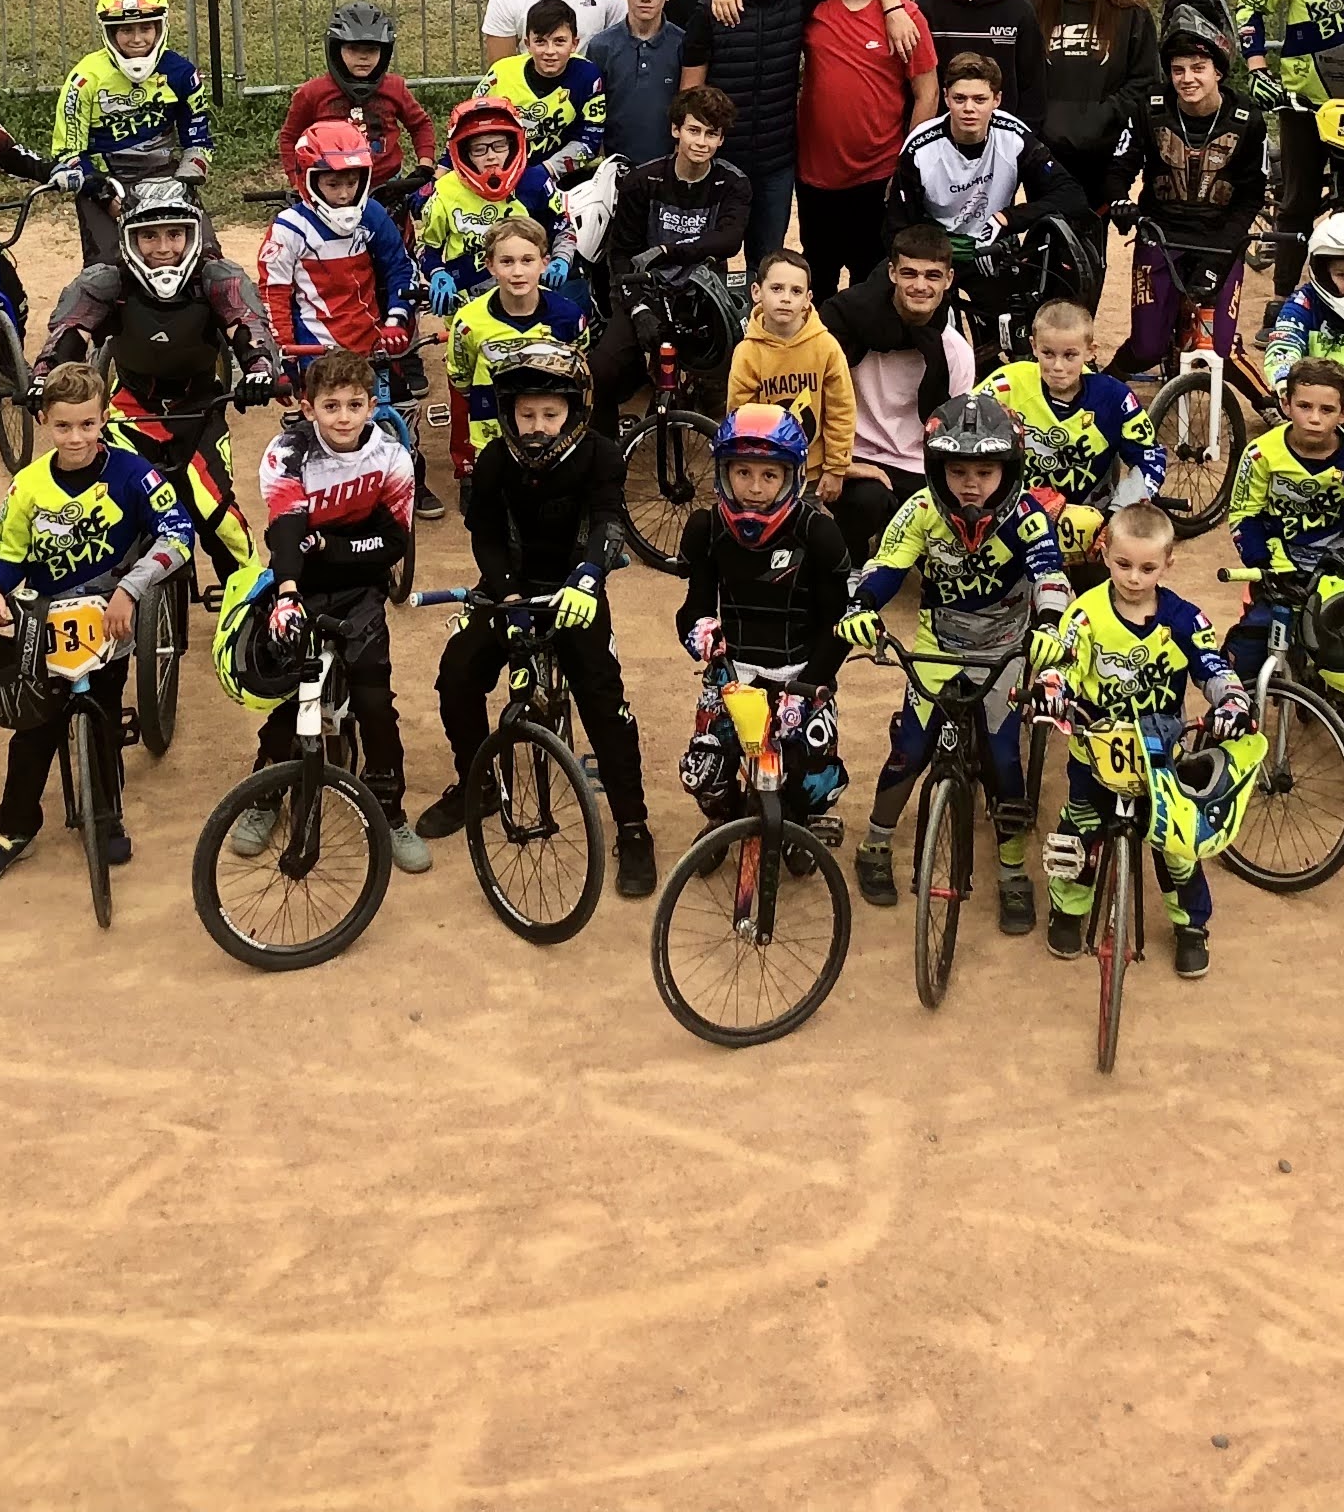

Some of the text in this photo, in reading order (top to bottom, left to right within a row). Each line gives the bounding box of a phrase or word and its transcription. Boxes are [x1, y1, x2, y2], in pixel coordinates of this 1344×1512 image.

[989, 25, 1018, 37] NASA
[587, 101, 607, 118] 65
[658, 207, 708, 228] Les Gets
[245, 371, 273, 385] FOX
[755, 372, 818, 404] PIKACHU
[1131, 418, 1154, 442] 39
[156, 489, 175, 507] 03
[305, 469, 385, 514] THOR
[32, 505, 111, 562] ISSOIRE
[1024, 519, 1041, 536] 11
[1282, 505, 1341, 539] BMX
[46, 530, 115, 581] BMX
[349, 535, 385, 553] THOR
[929, 544, 1001, 582] ISSOIRE
[936, 572, 1003, 604] BMX
[1097, 651, 1175, 707] ISSOIRE
